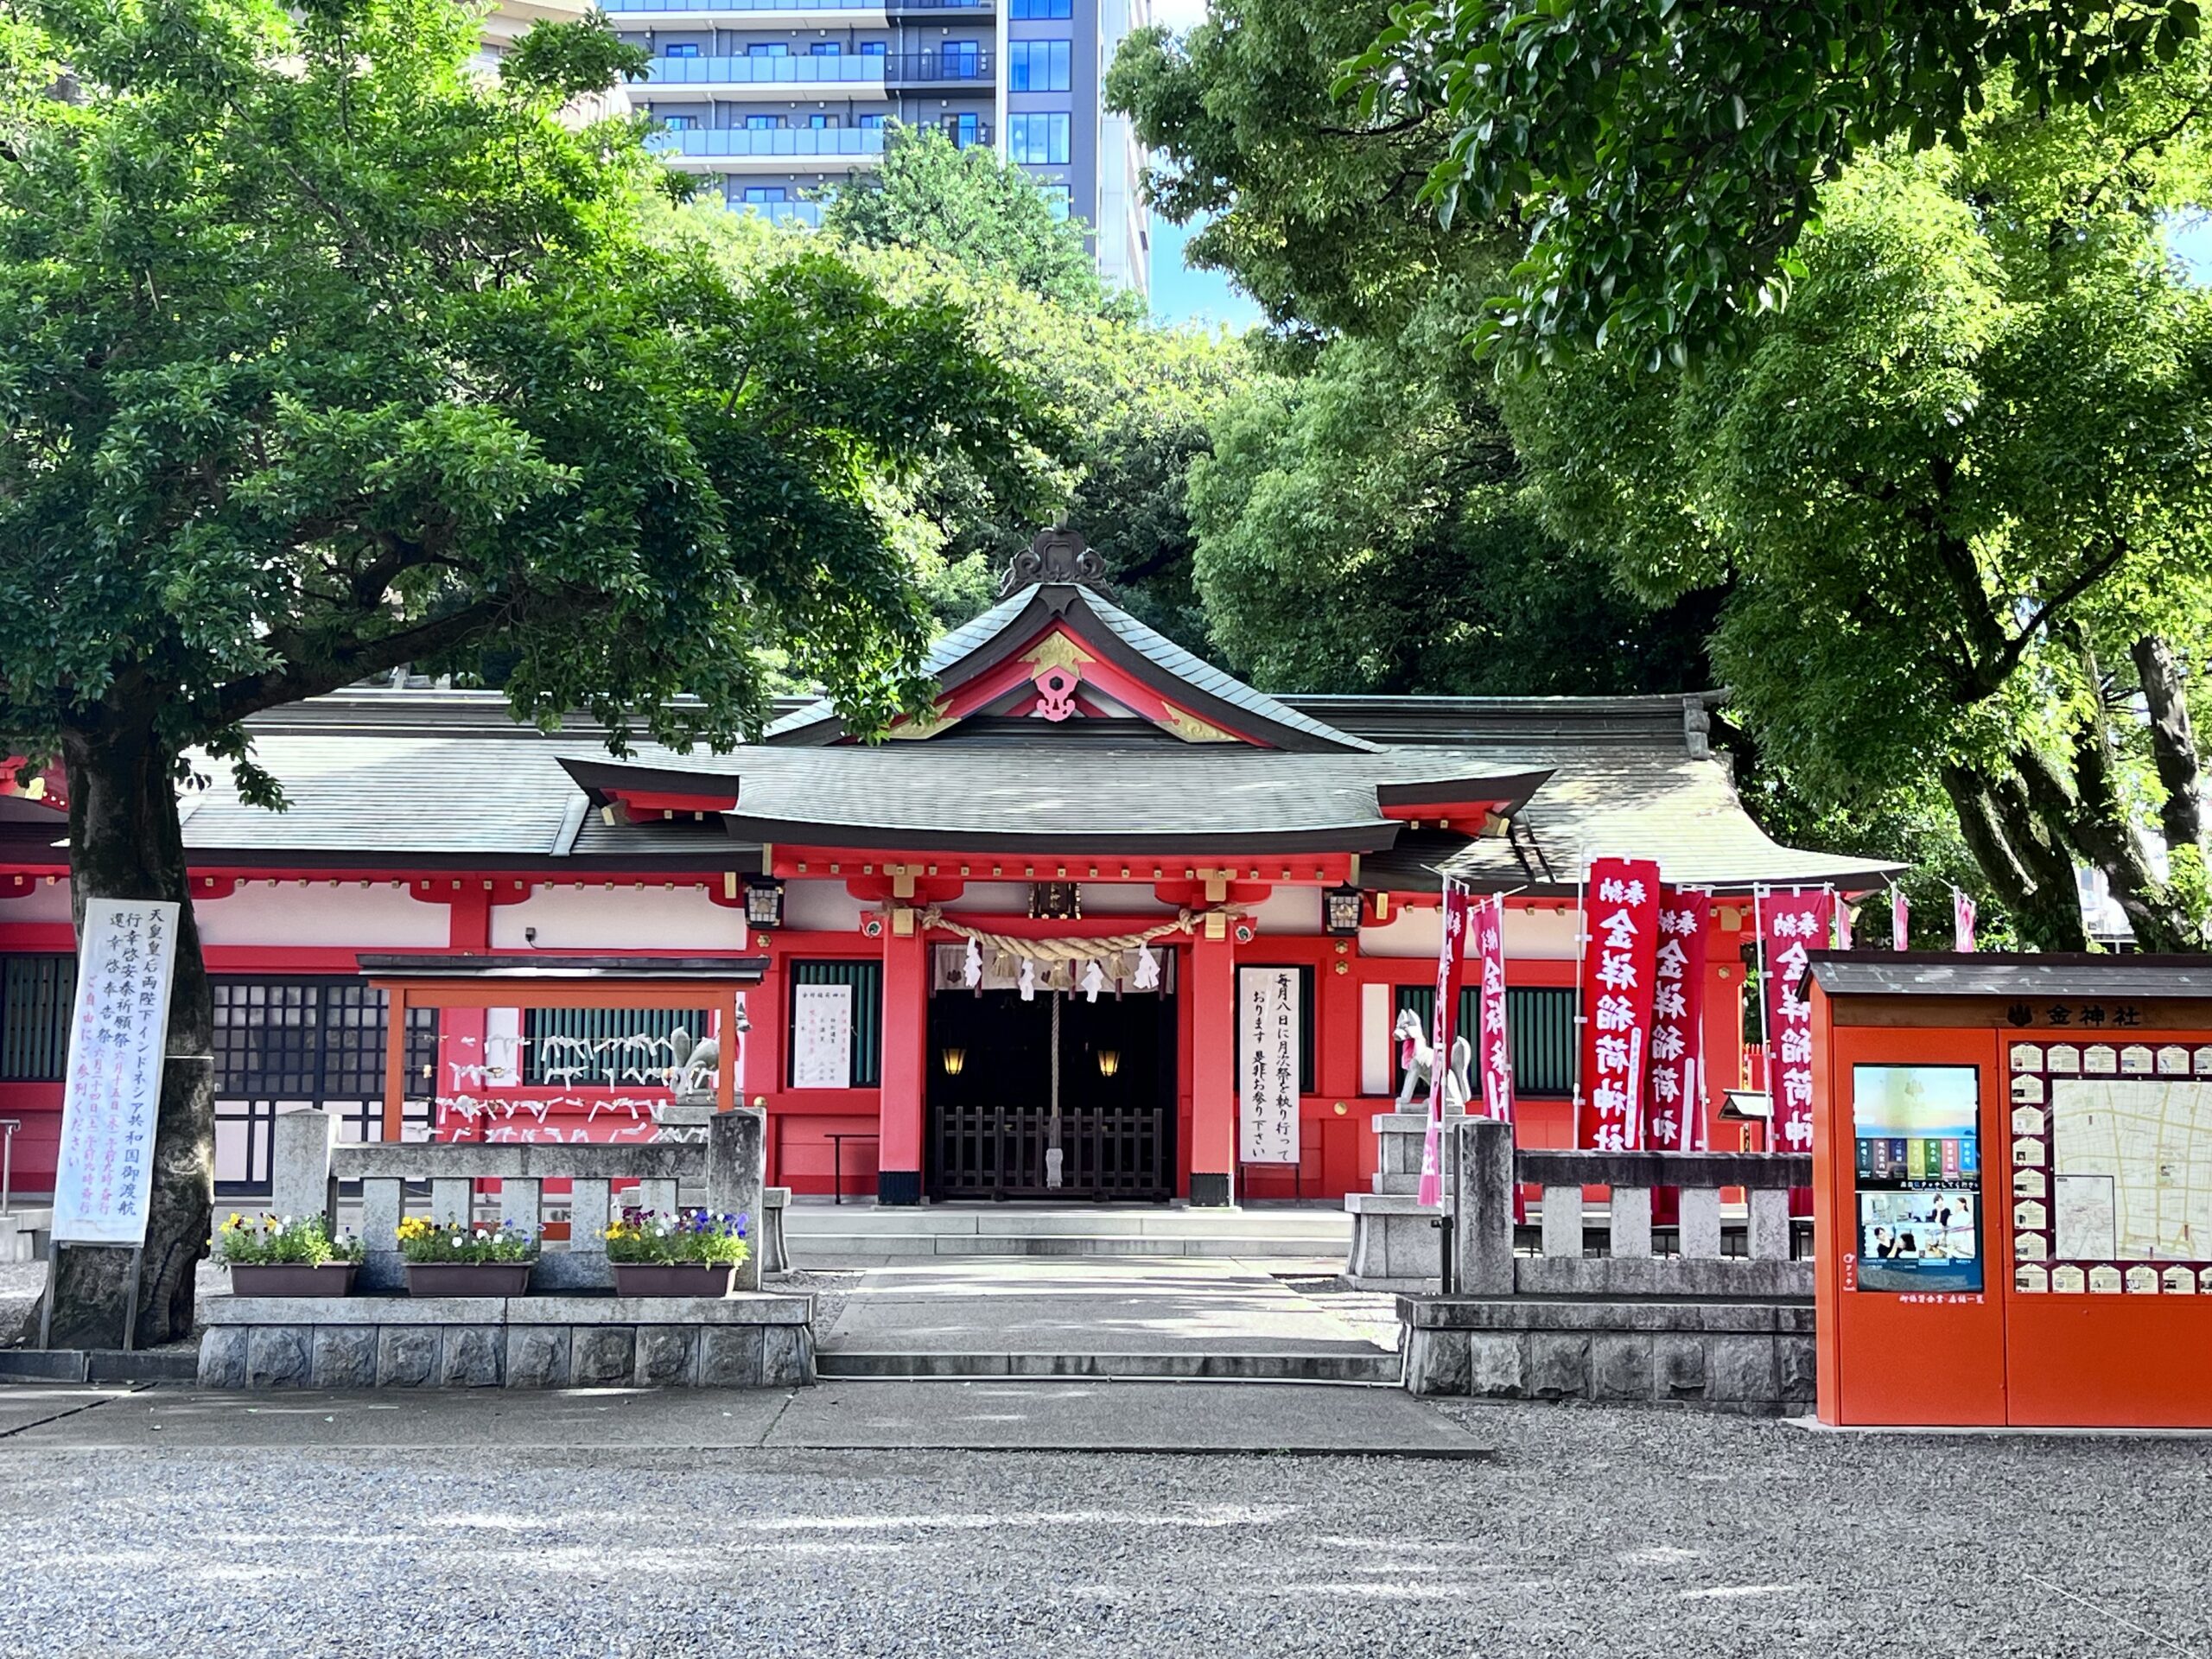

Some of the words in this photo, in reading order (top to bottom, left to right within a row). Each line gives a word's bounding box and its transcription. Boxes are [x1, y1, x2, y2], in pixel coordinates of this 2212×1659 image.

[1252, 991, 1266, 1044] おります
[2045, 1003, 2141, 1027] 金神社
[1275, 974, 1293, 1160] 毎月八日に月次祭を執り行って
